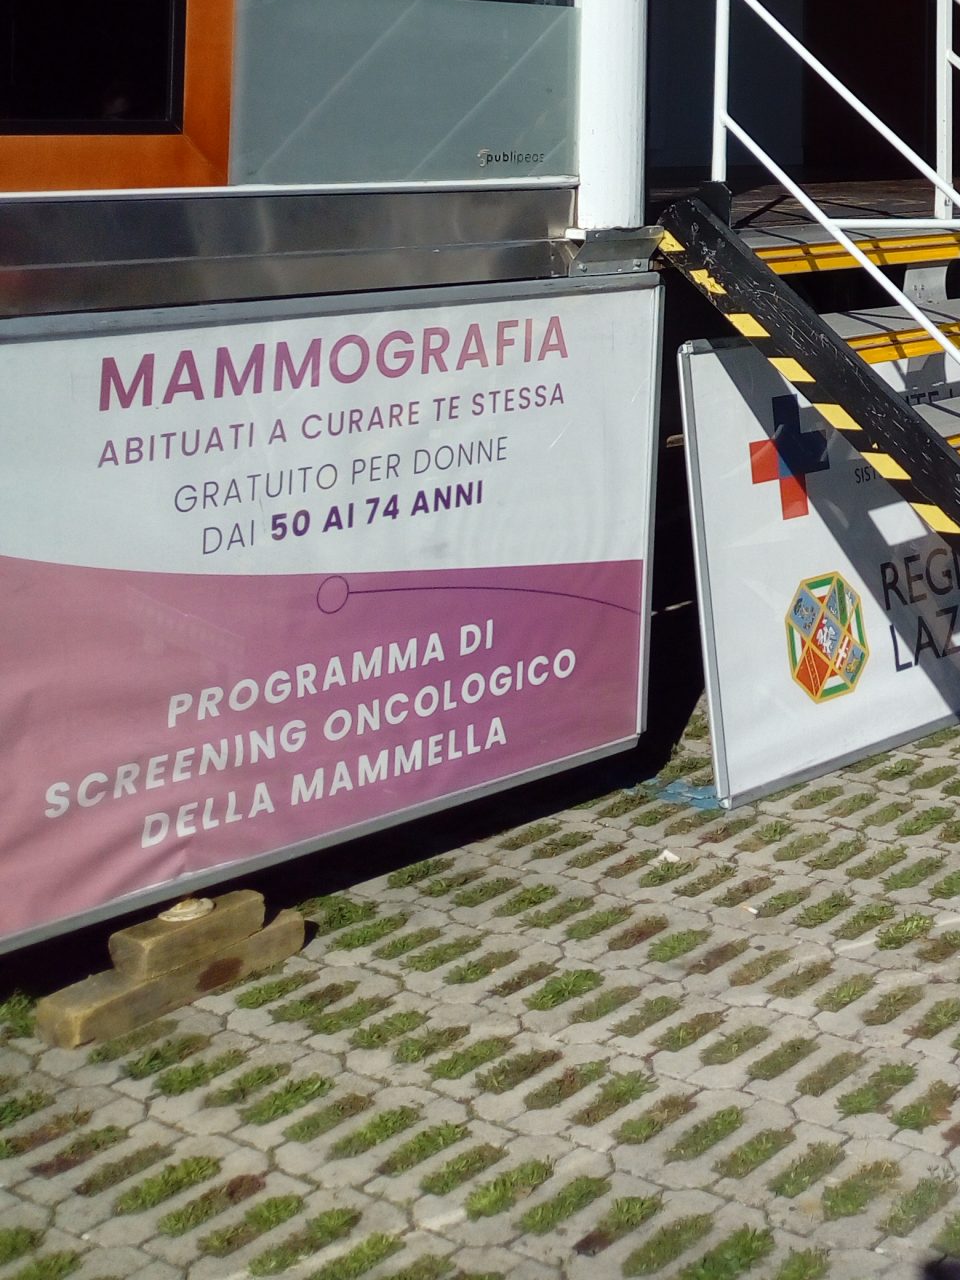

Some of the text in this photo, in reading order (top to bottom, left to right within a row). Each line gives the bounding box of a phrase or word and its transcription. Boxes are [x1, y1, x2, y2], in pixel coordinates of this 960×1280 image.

[99, 316, 569, 411] MAMMOGRAFIA
[98, 383, 565, 468] ABITUATI A CURARE TE STESSA
[174, 437, 508, 513] GRATUITO PER DONNE
[203, 481, 484, 554] DAI 50 AI 74 ANNI
[167, 619, 494, 728] PROGRAMMA DI
[45, 649, 576, 818] SCREENING ONCOLOGICO
[141, 717, 508, 848] DELLA MAMMELLA
